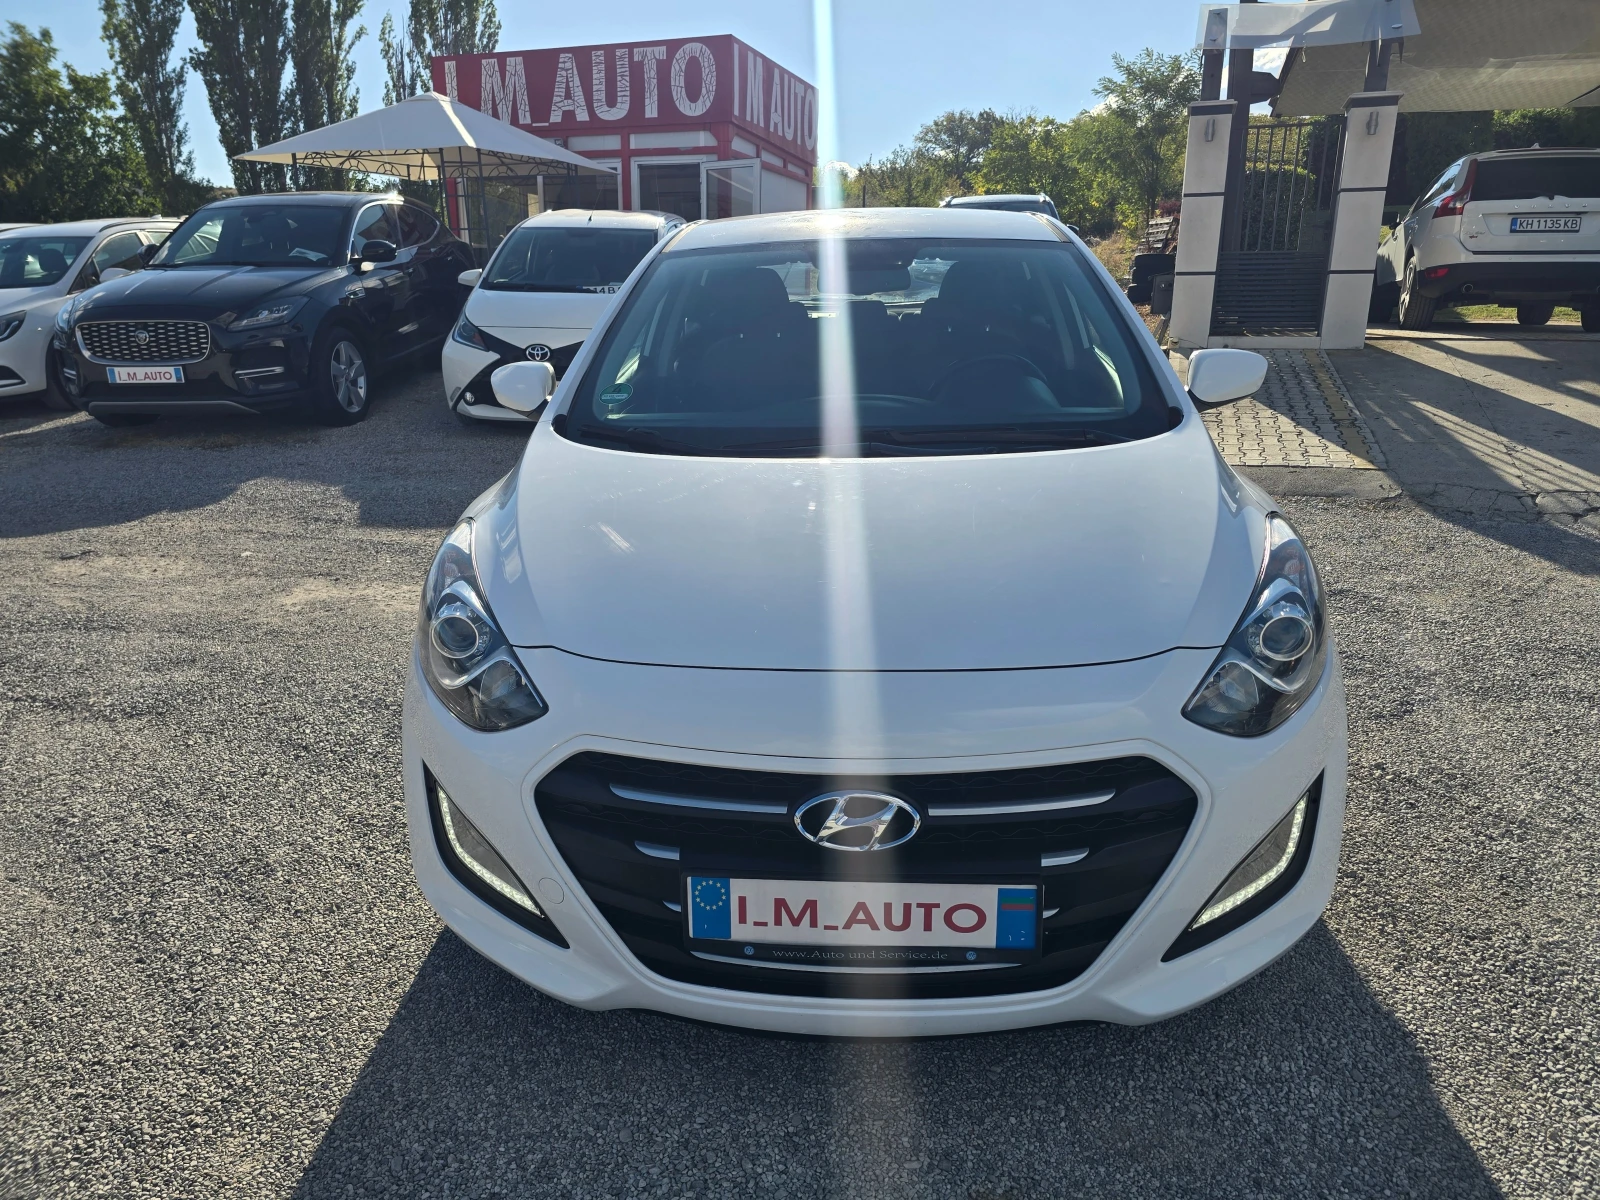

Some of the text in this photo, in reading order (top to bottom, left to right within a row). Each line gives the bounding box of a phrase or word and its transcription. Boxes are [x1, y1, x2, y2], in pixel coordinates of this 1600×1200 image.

[746, 50, 764, 127] M
[769, 67, 815, 151] AUTO
[1518, 219, 1578, 229] KH 1135 KB
[737, 895, 987, 934] I_M_AUTO
[772, 950, 948, 960] www.Auto und Service.de
